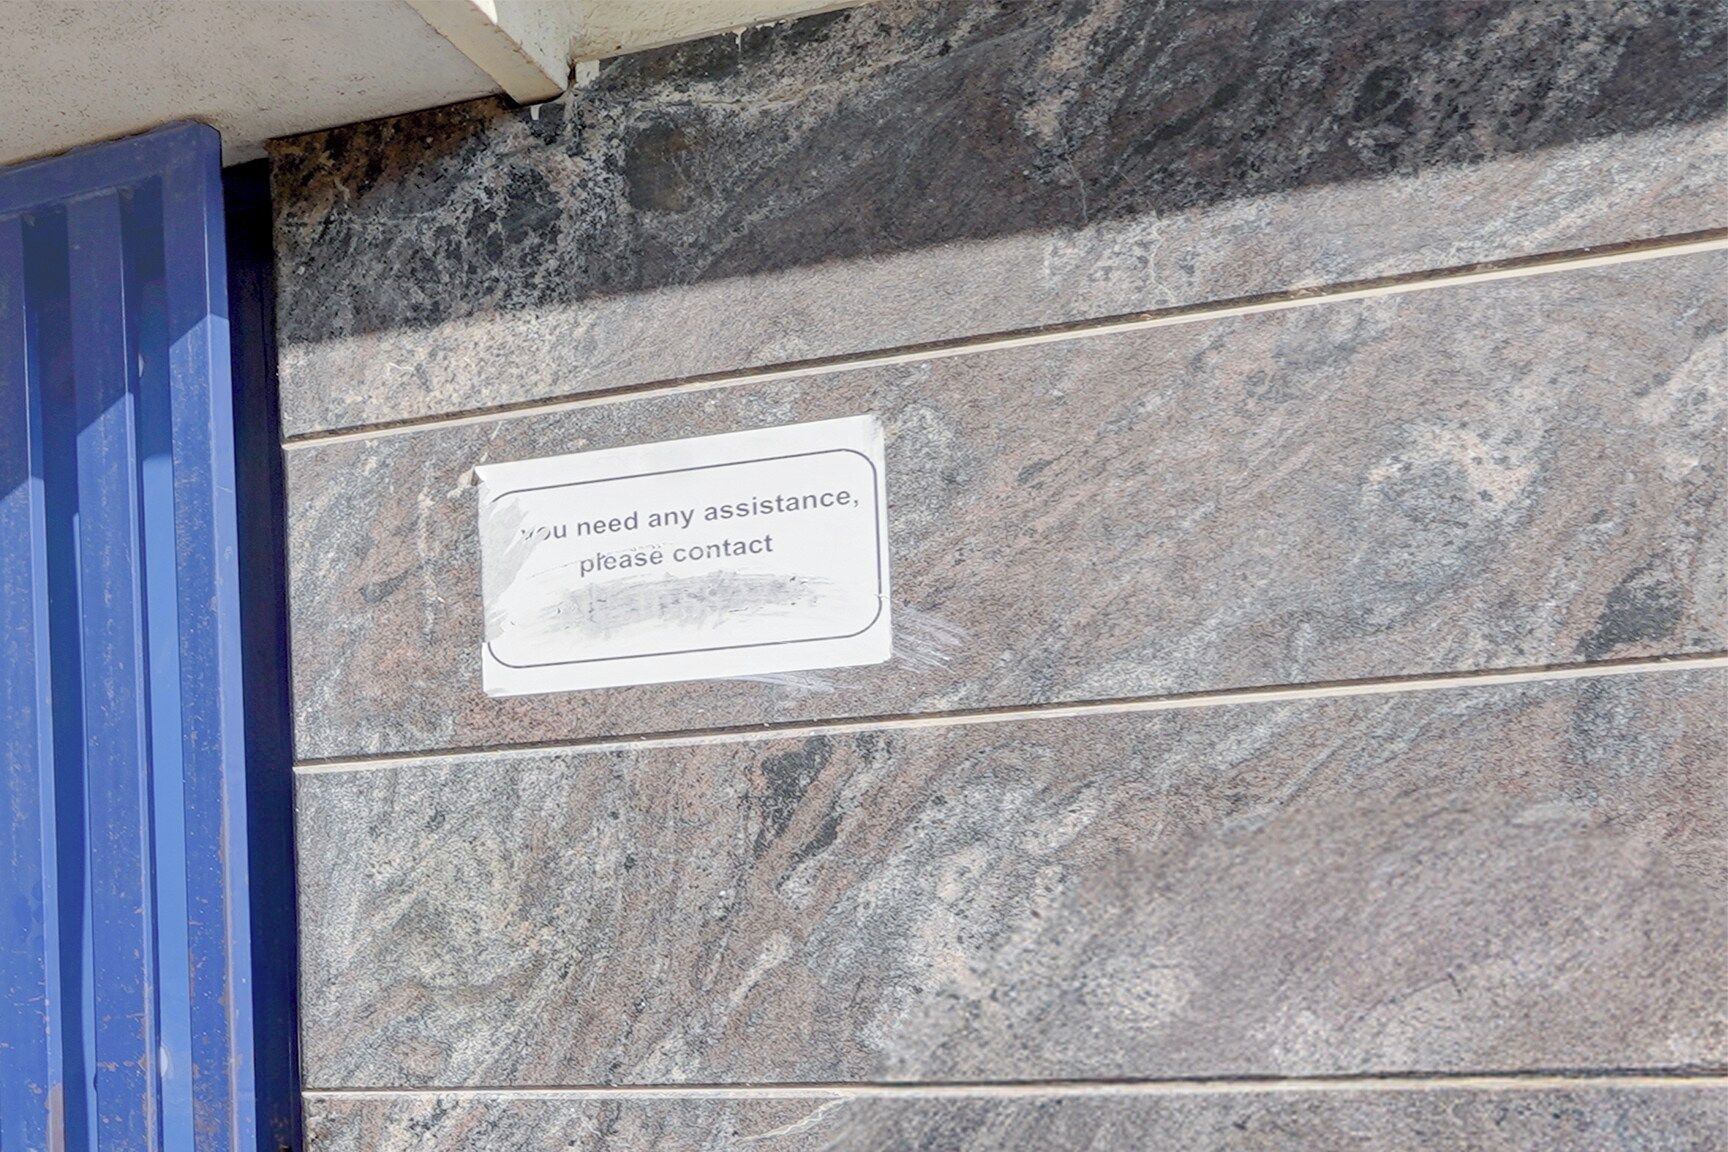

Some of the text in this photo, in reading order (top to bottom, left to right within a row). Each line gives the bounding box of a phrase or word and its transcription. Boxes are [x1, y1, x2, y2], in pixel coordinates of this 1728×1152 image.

[576, 511, 638, 537] need
[648, 508, 695, 529] any
[704, 490, 859, 522] assistance,
[580, 534, 774, 578] please contact
